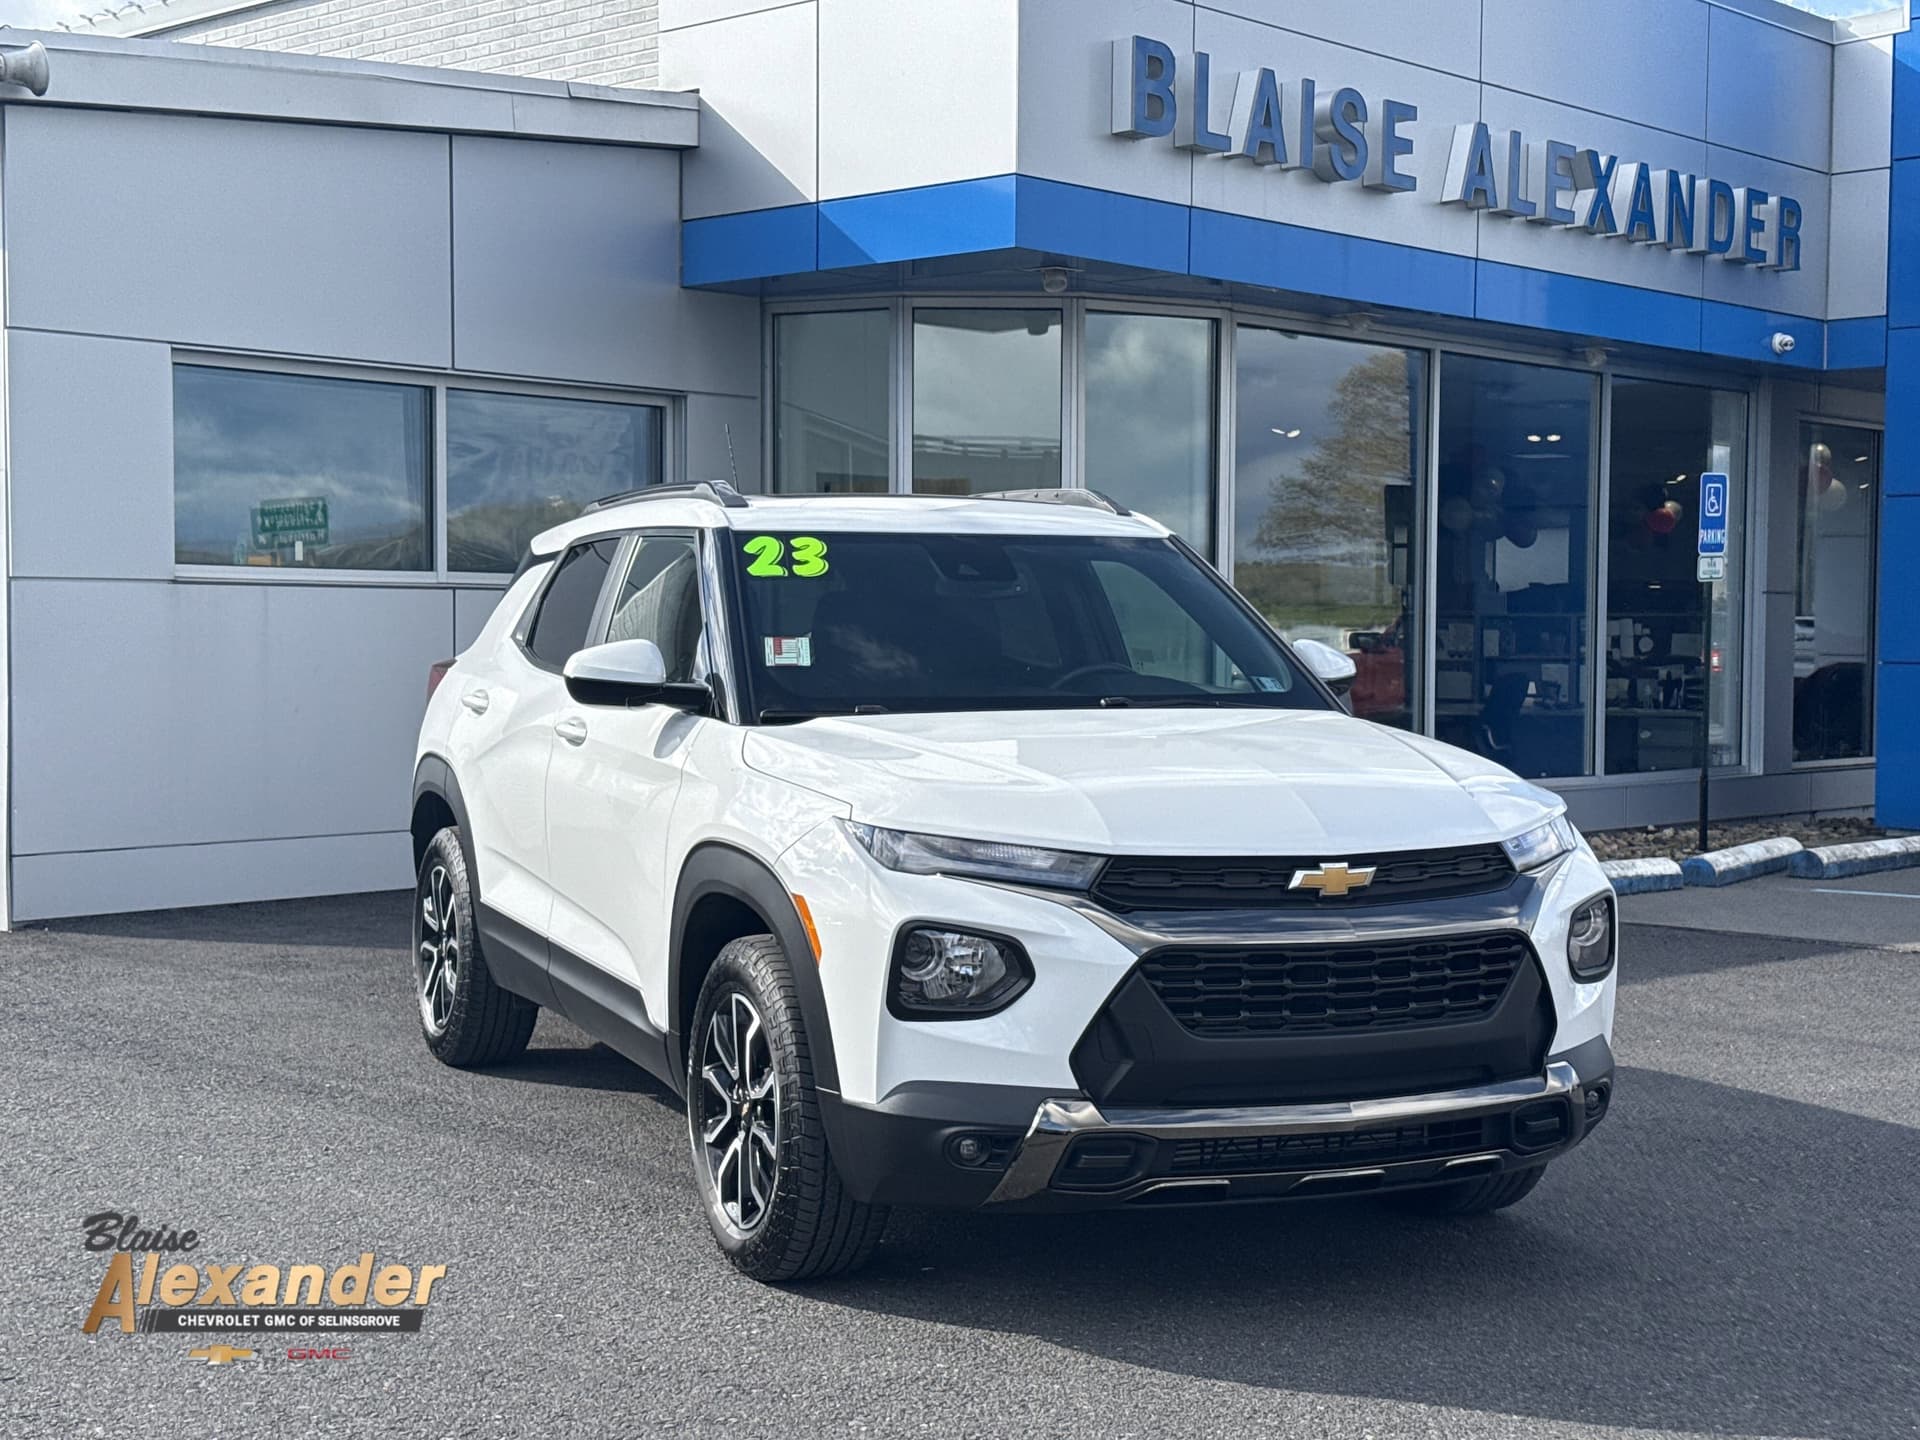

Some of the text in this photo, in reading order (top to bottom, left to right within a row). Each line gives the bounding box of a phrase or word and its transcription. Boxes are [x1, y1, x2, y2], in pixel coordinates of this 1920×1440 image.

[1112, 34, 1804, 272] BLAISE ALEXANDER
[743, 535, 829, 578] 23
[1699, 529, 1726, 544] PARKING
